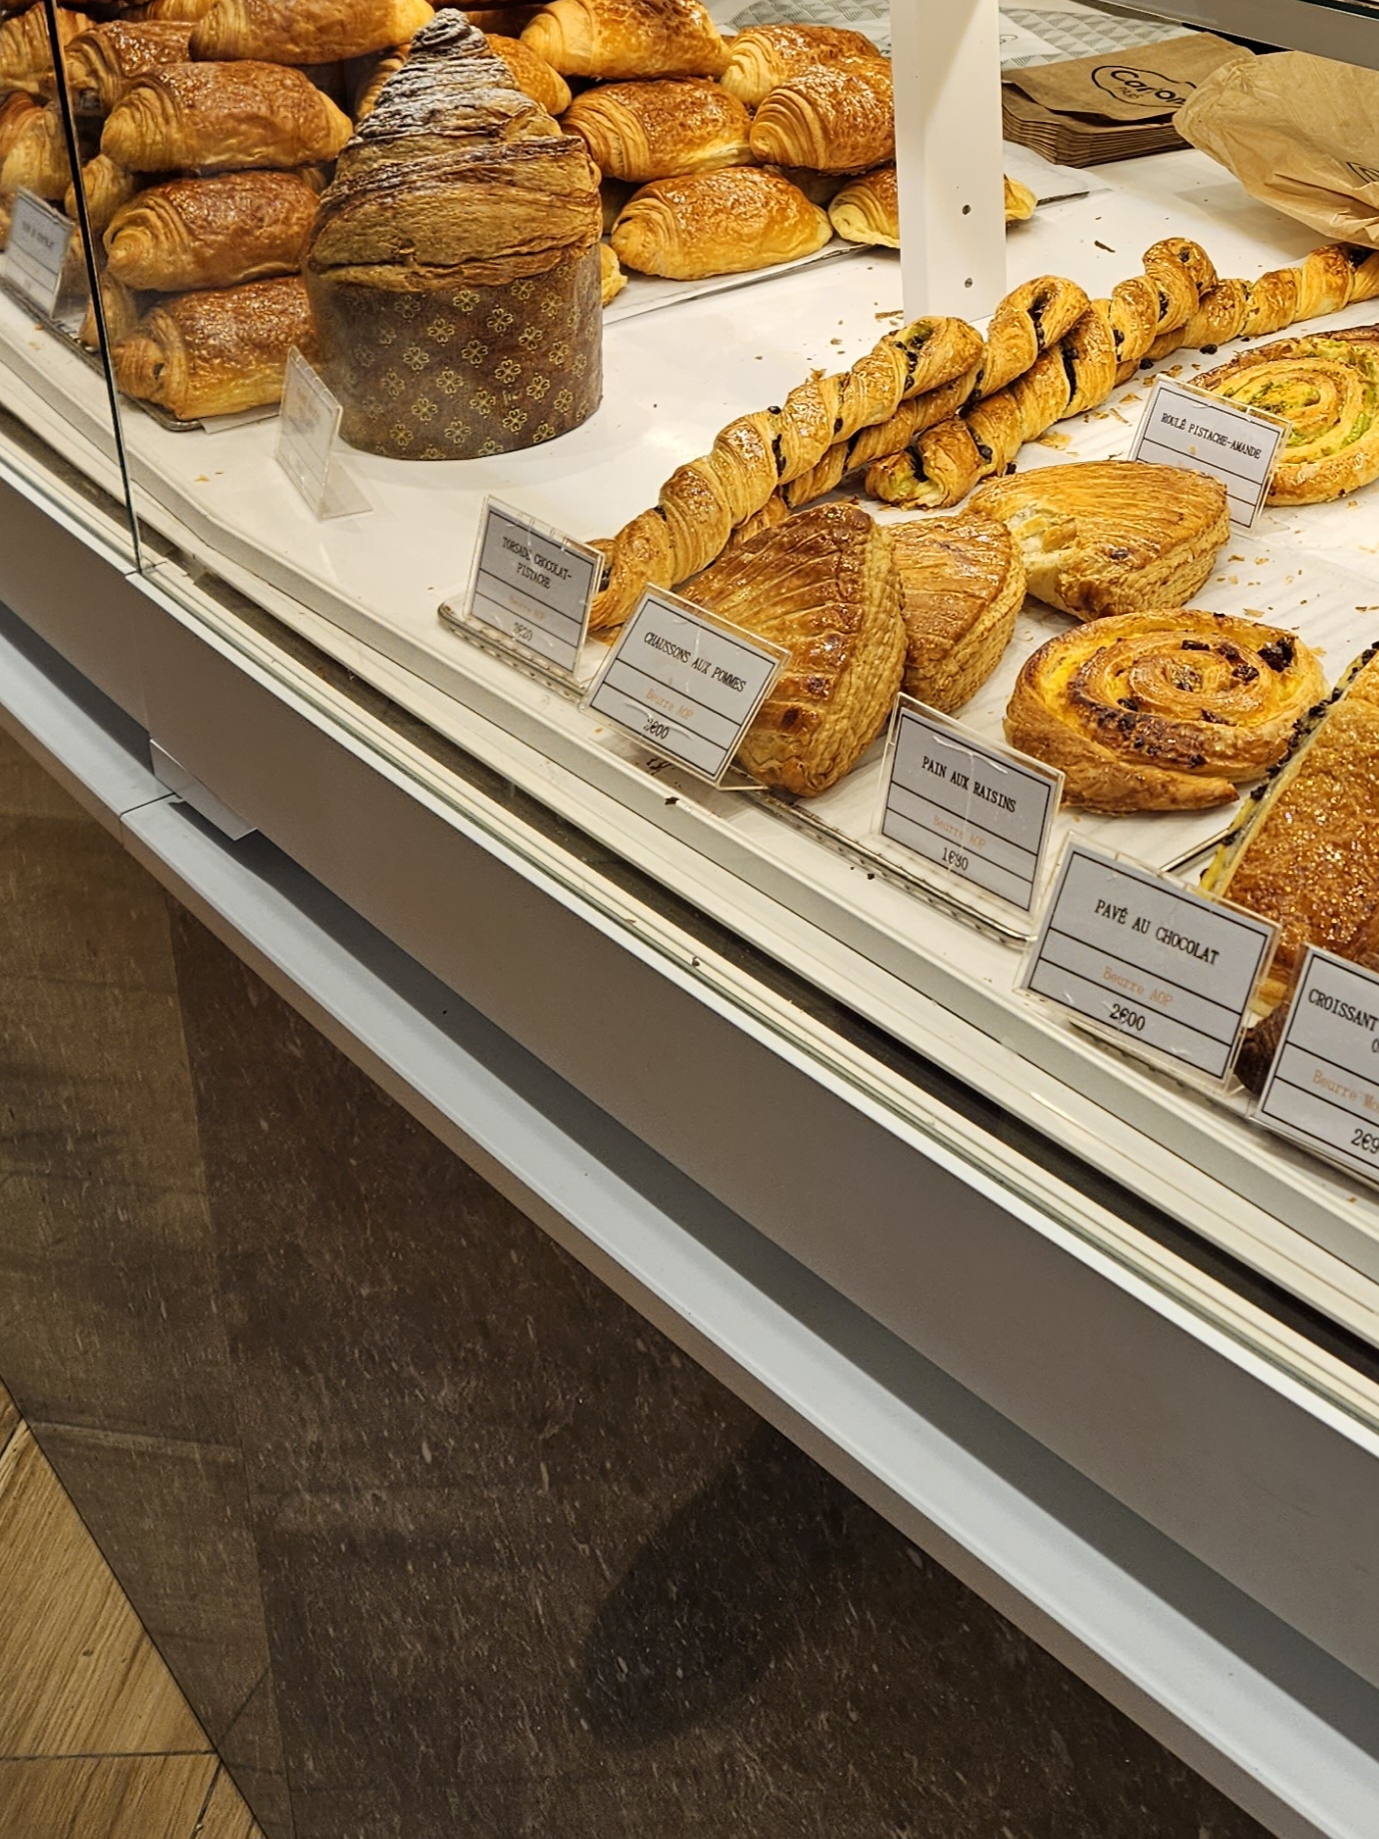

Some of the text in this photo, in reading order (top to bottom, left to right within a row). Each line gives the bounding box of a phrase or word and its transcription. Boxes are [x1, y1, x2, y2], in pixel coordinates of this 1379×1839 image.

[1160, 412, 1262, 459] ROULÉ PISTACHE-AMANDE
[644, 632, 747, 692] CHAUSSONS AUX POMMES
[921, 756, 1017, 813] PAIN AUX RAISINS
[1094, 899, 1220, 965] PAVÉ AU CHOCOLAT
[1103, 965, 1174, 1007] Beurre AOP
[1109, 1003, 1146, 1032] 2€00
[1308, 988, 1379, 1031] CROISSANT
[1312, 1069, 1357, 1102] Beurre
